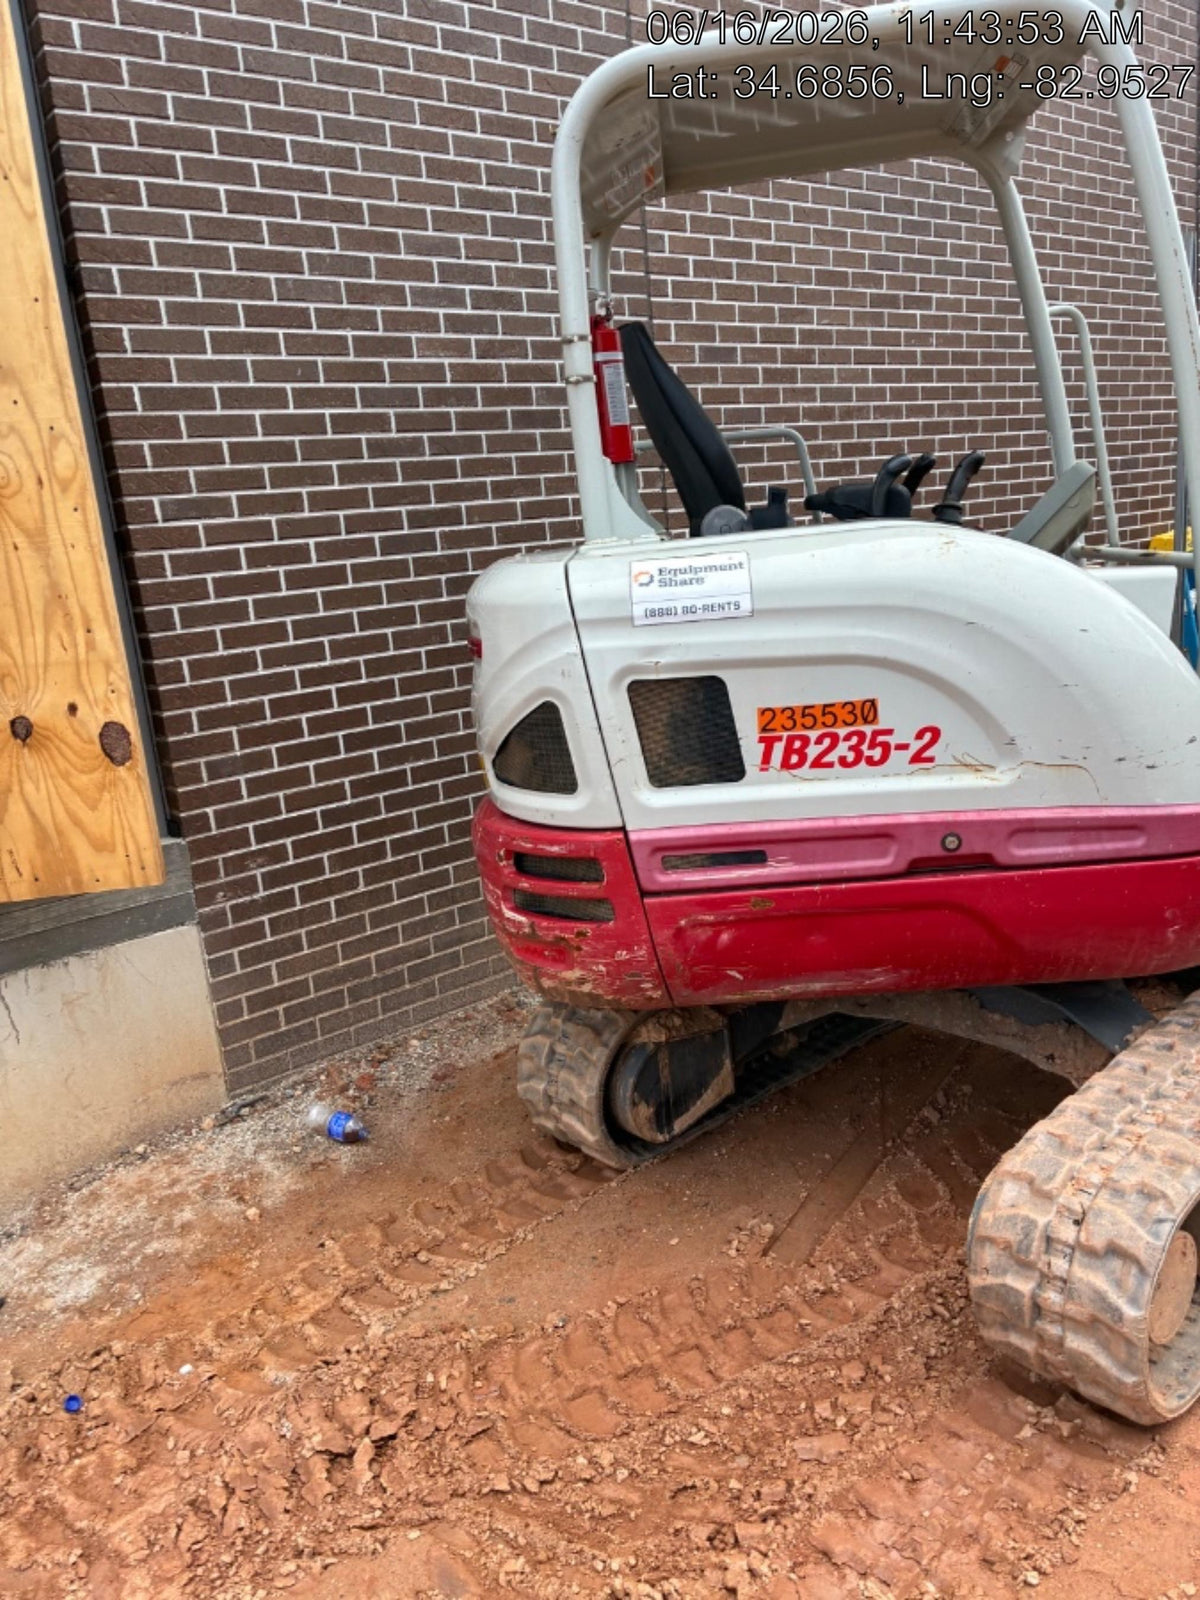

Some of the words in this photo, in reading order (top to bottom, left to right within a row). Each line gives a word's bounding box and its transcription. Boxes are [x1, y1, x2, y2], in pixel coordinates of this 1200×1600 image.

[657, 560, 745, 579] Equipment
[657, 576, 705, 588] Share
[644, 606, 678, 619] (888)
[759, 699, 878, 733] 235530
[757, 725, 941, 772] TB235-2
